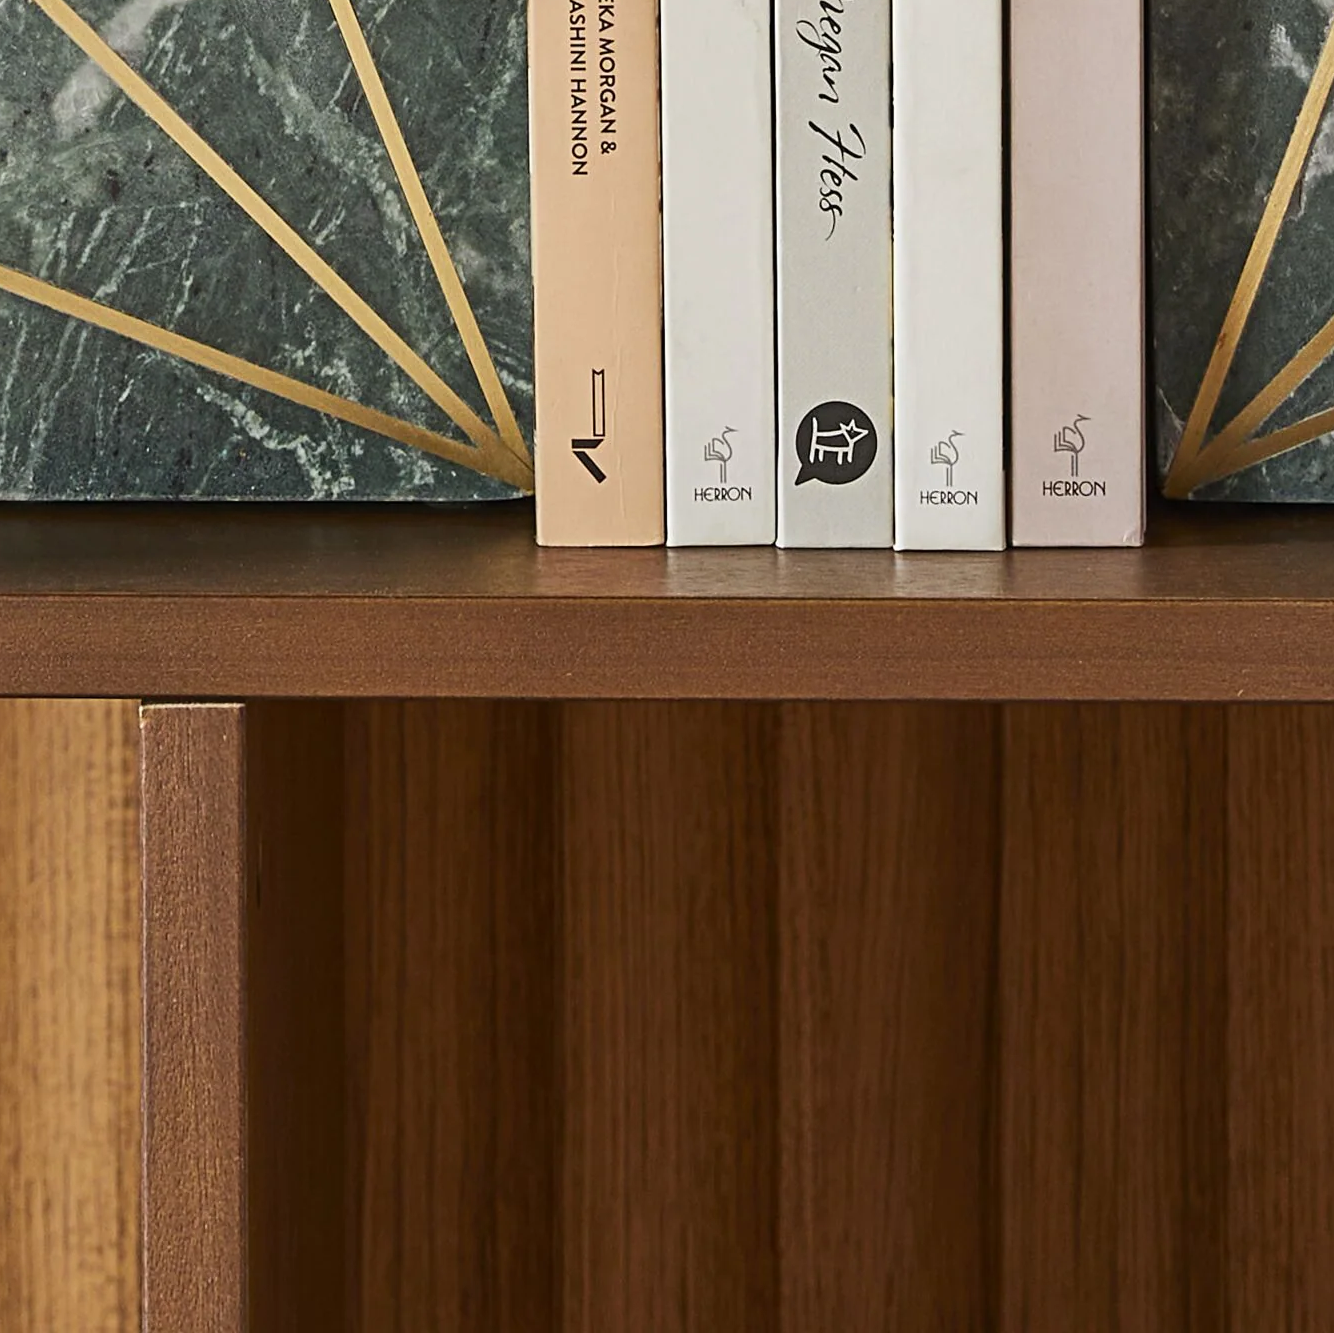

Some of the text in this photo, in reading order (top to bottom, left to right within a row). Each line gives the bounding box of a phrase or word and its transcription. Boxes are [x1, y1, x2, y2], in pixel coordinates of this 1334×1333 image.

[599, 38, 616, 133] MORGAN
[571, 79, 588, 175] HANNON
[601, 141, 616, 154] &
[809, 121, 866, 240] Hess
[695, 487, 751, 501] HERRON
[1043, 481, 1105, 496] HERRON
[921, 491, 977, 505] HERRON
